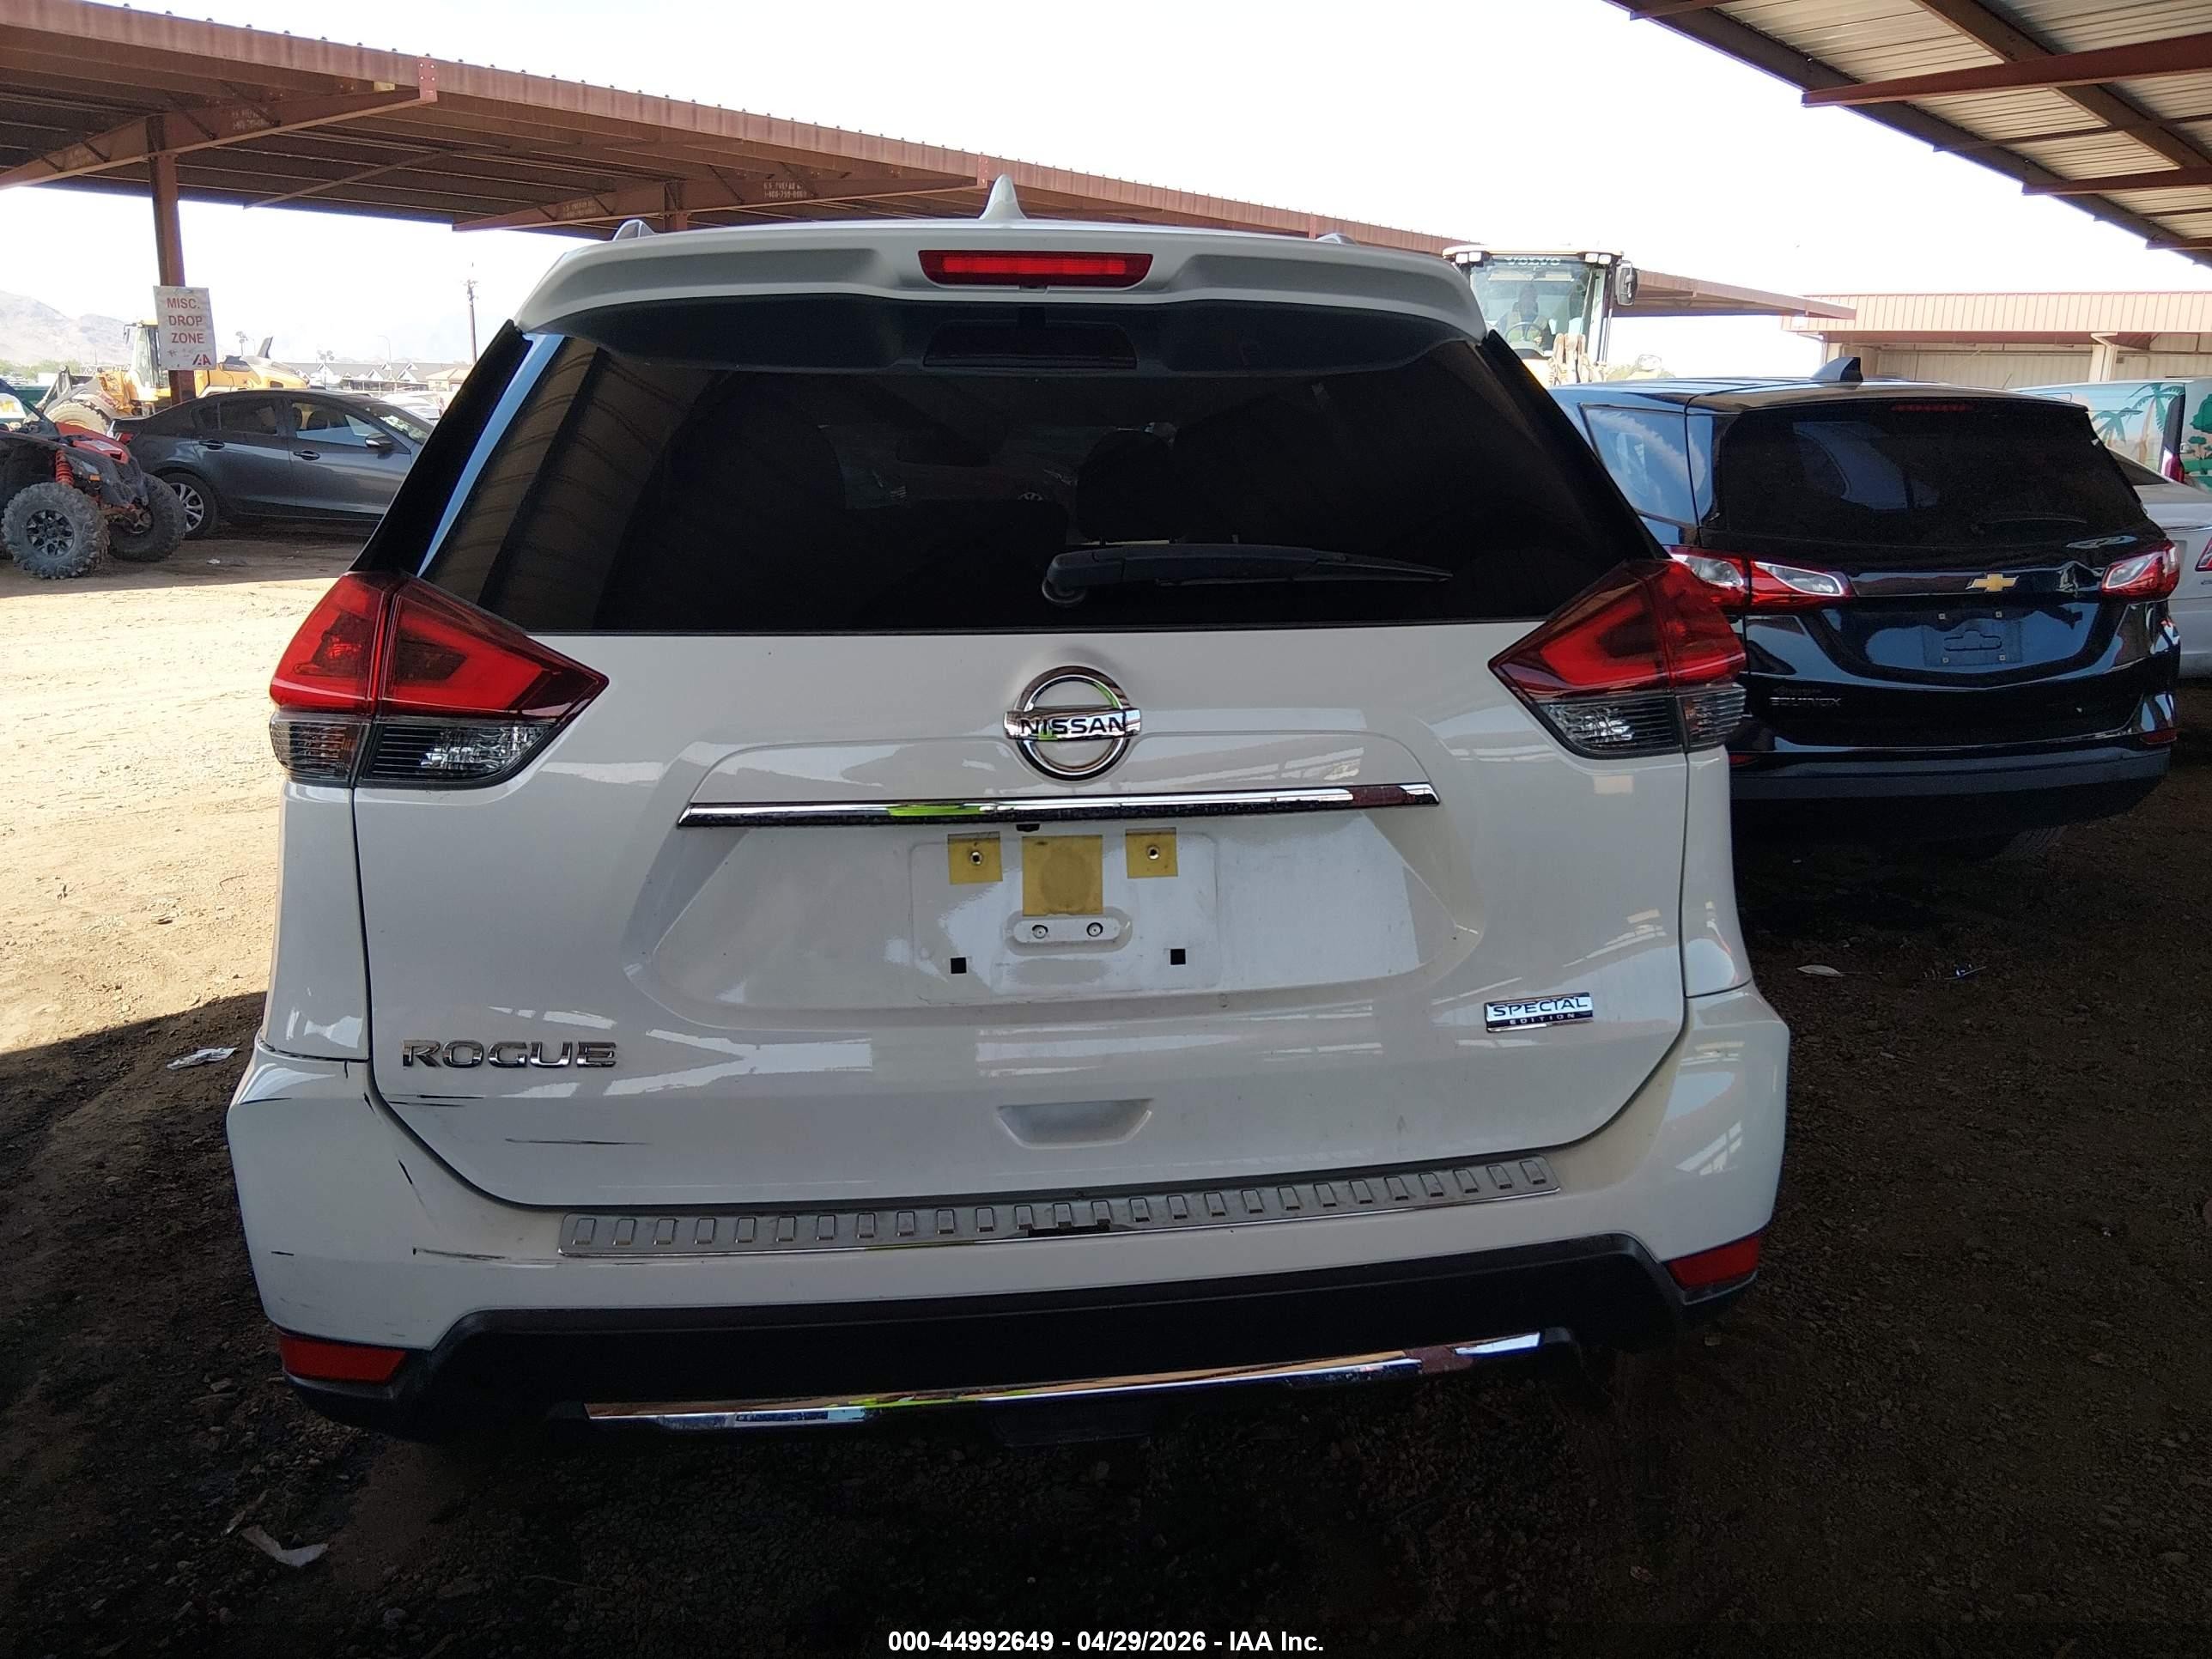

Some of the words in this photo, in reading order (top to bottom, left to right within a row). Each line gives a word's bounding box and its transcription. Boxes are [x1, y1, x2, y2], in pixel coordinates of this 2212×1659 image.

[1504, 256, 1561, 266] VOLVO
[167, 298, 200, 309] MISC.
[168, 315, 203, 326] DROP
[171, 332, 205, 343] ZONE
[1019, 715, 1127, 735] NISSAN
[1492, 998, 1588, 1018] SPECIAL
[1509, 1012, 1576, 1025] EDITION
[401, 1039, 617, 1068] ROGUE
